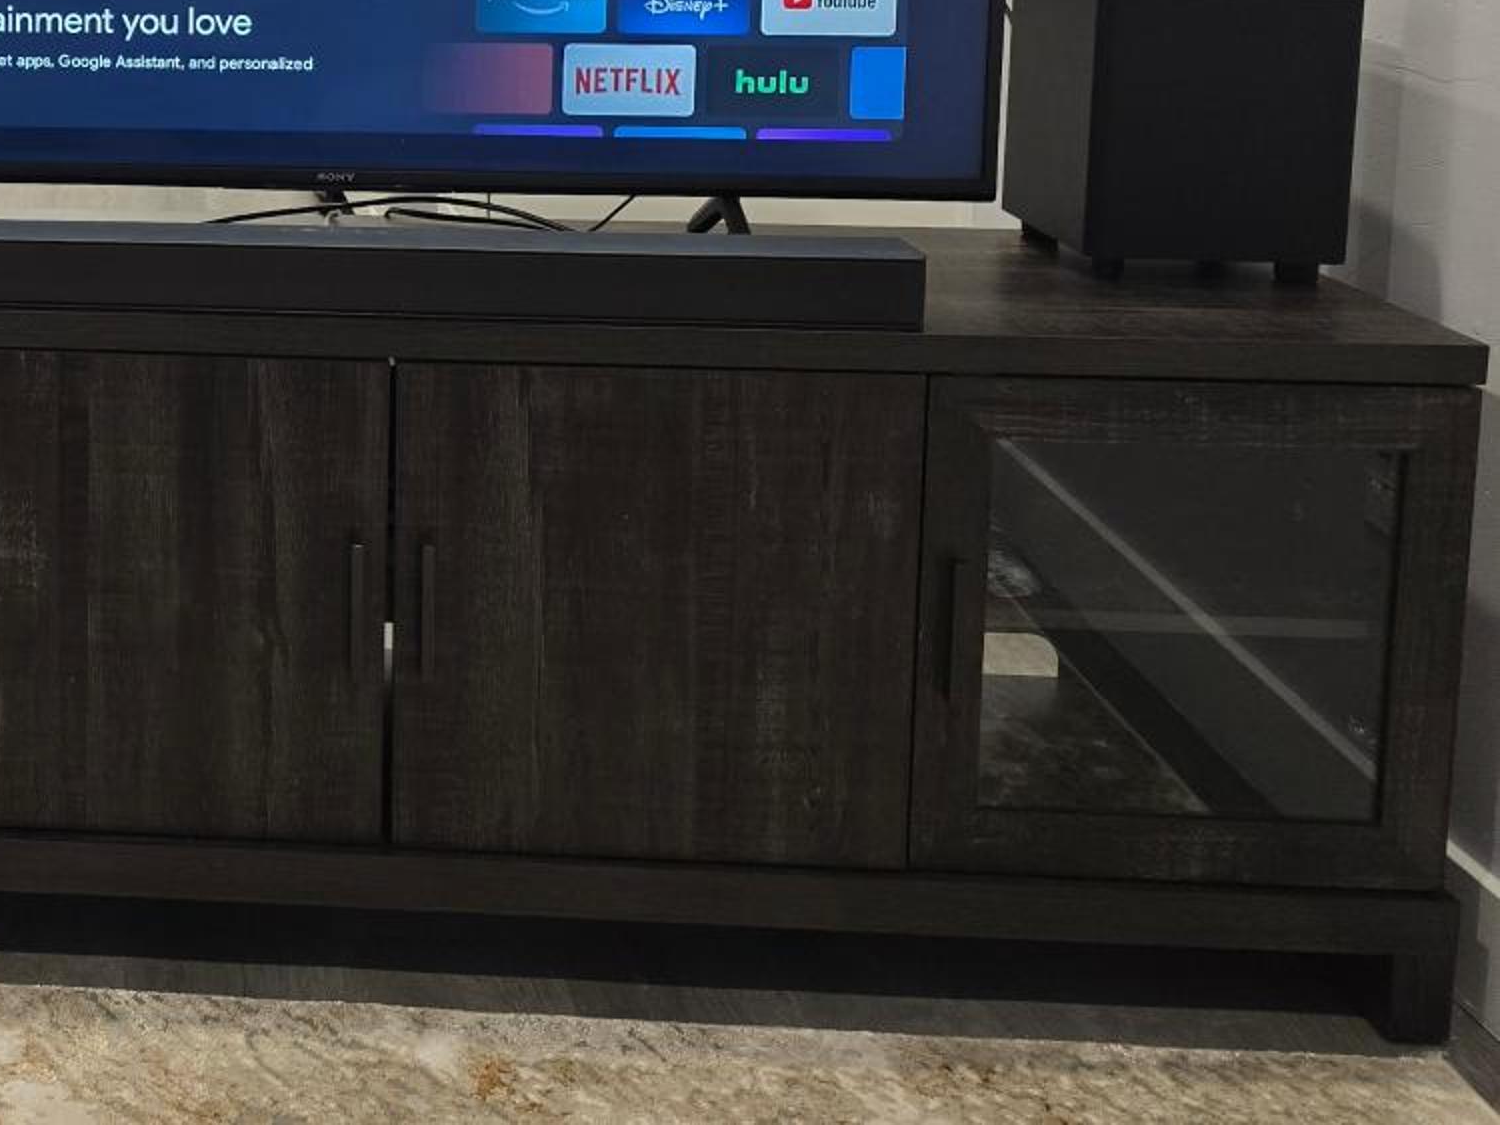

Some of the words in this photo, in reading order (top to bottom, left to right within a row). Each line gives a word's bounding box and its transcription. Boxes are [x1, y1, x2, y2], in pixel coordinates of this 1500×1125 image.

[122, 17, 179, 41] you
[188, 7, 253, 36] love
[58, 54, 111, 71] Google
[115, 54, 185, 70] Assistant,
[188, 56, 216, 69] and
[219, 56, 313, 72] personalized
[575, 67, 682, 96] NETFLIX
[735, 68, 809, 94] hulu
